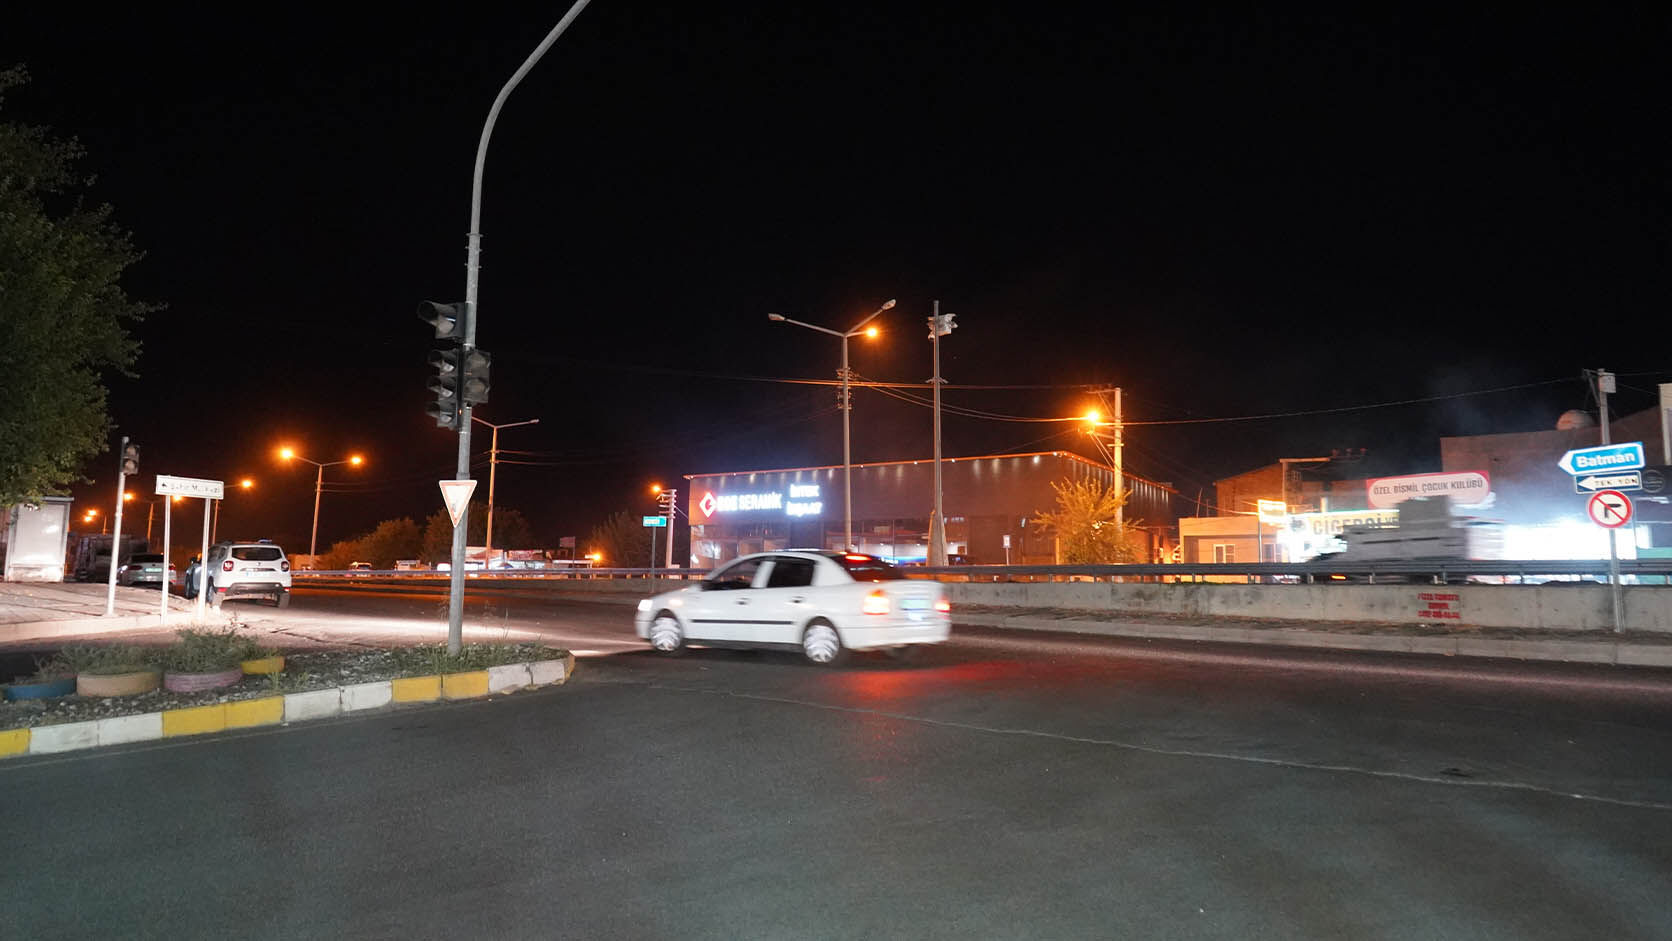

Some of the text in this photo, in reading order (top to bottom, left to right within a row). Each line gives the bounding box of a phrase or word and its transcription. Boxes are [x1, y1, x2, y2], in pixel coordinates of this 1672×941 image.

[1576, 453, 1635, 468] Batman
[1374, 485, 1391, 495] ÖZEL
[1422, 481, 1448, 493] ÇOCUK
